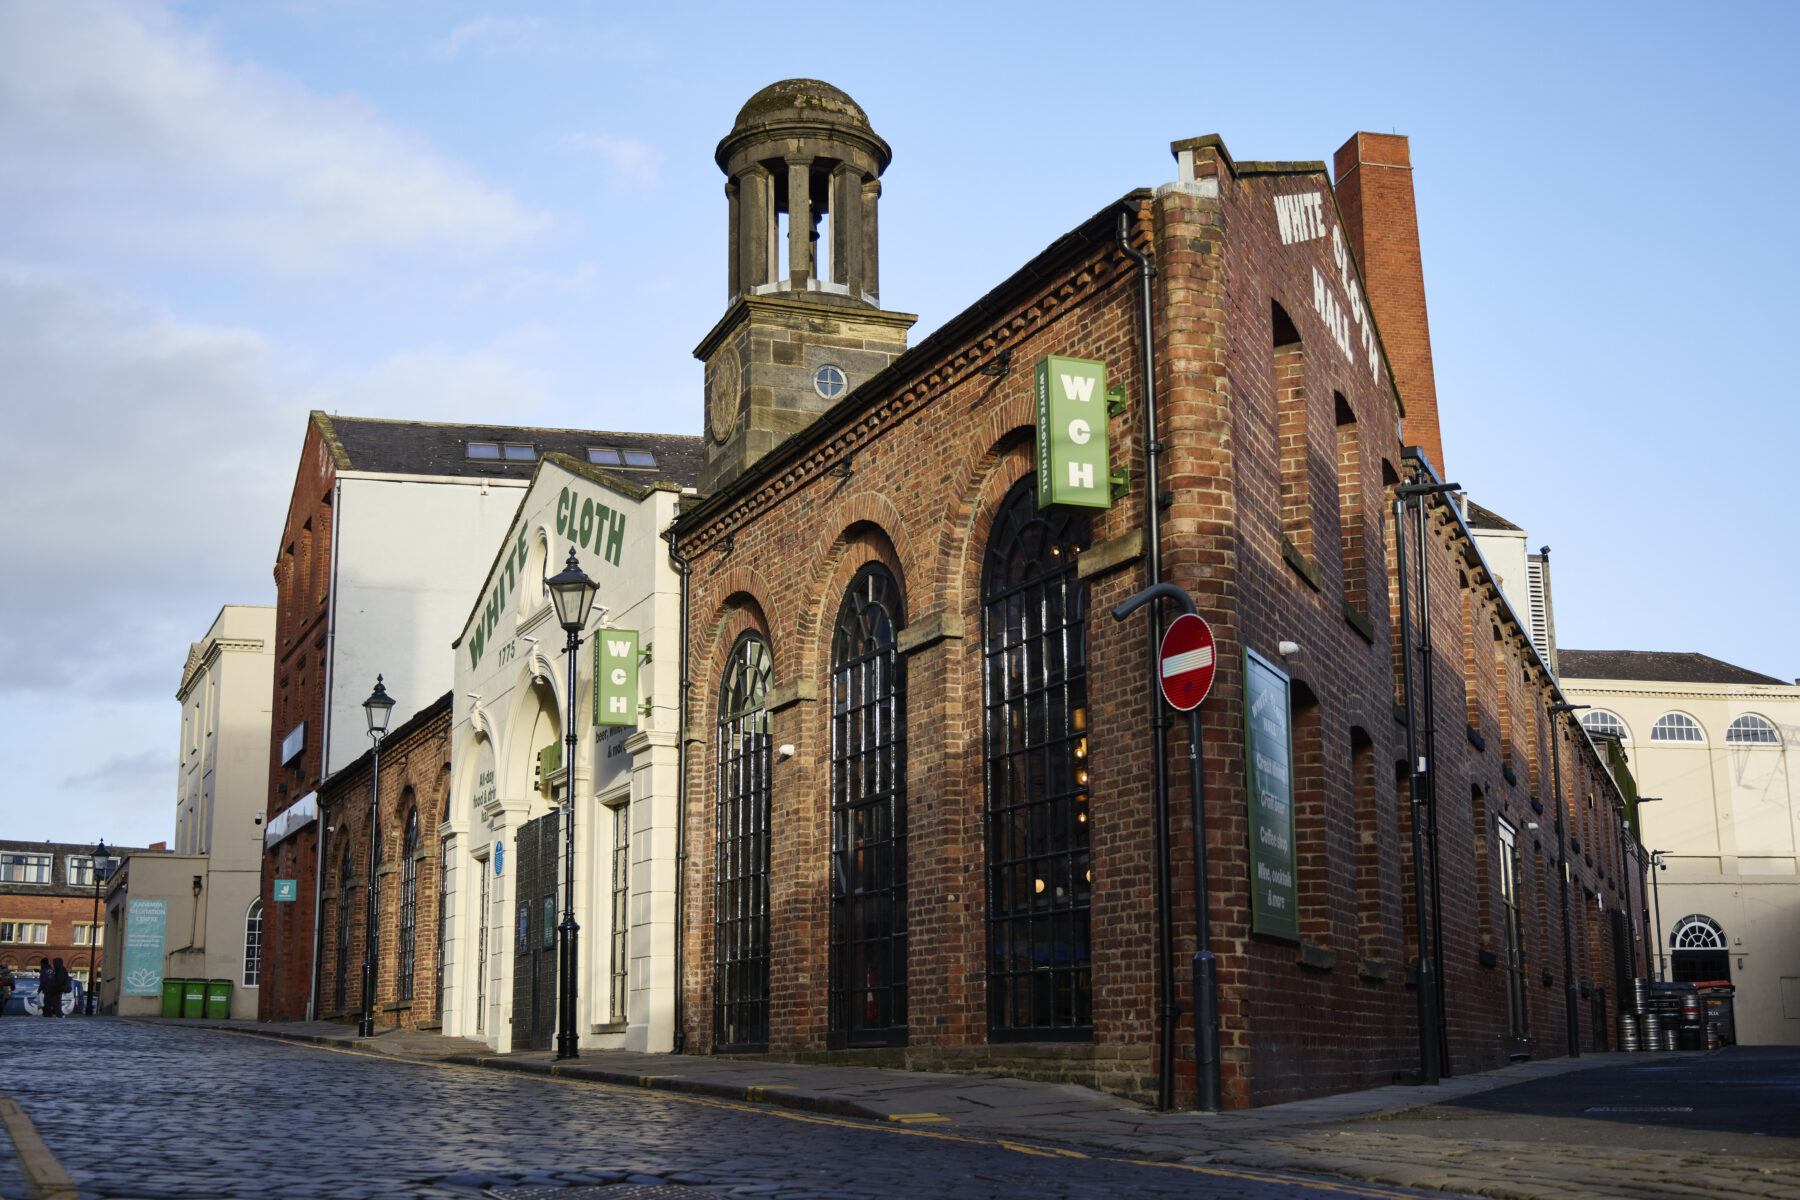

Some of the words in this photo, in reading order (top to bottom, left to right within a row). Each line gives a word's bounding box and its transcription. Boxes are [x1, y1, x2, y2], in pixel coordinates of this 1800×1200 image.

[1273, 192, 1326, 245] WHITE
[1332, 224, 1379, 386] CLOTH
[1312, 265, 1354, 364] HALL
[468, 519, 529, 672] WHITE
[556, 486, 626, 567] CLOTH
[499, 639, 516, 667] 1775
[479, 769, 495, 787] All-day
[473, 790, 484, 808] food
[1260, 826, 1277, 848] Coffee
[1277, 833, 1288, 856] shop
